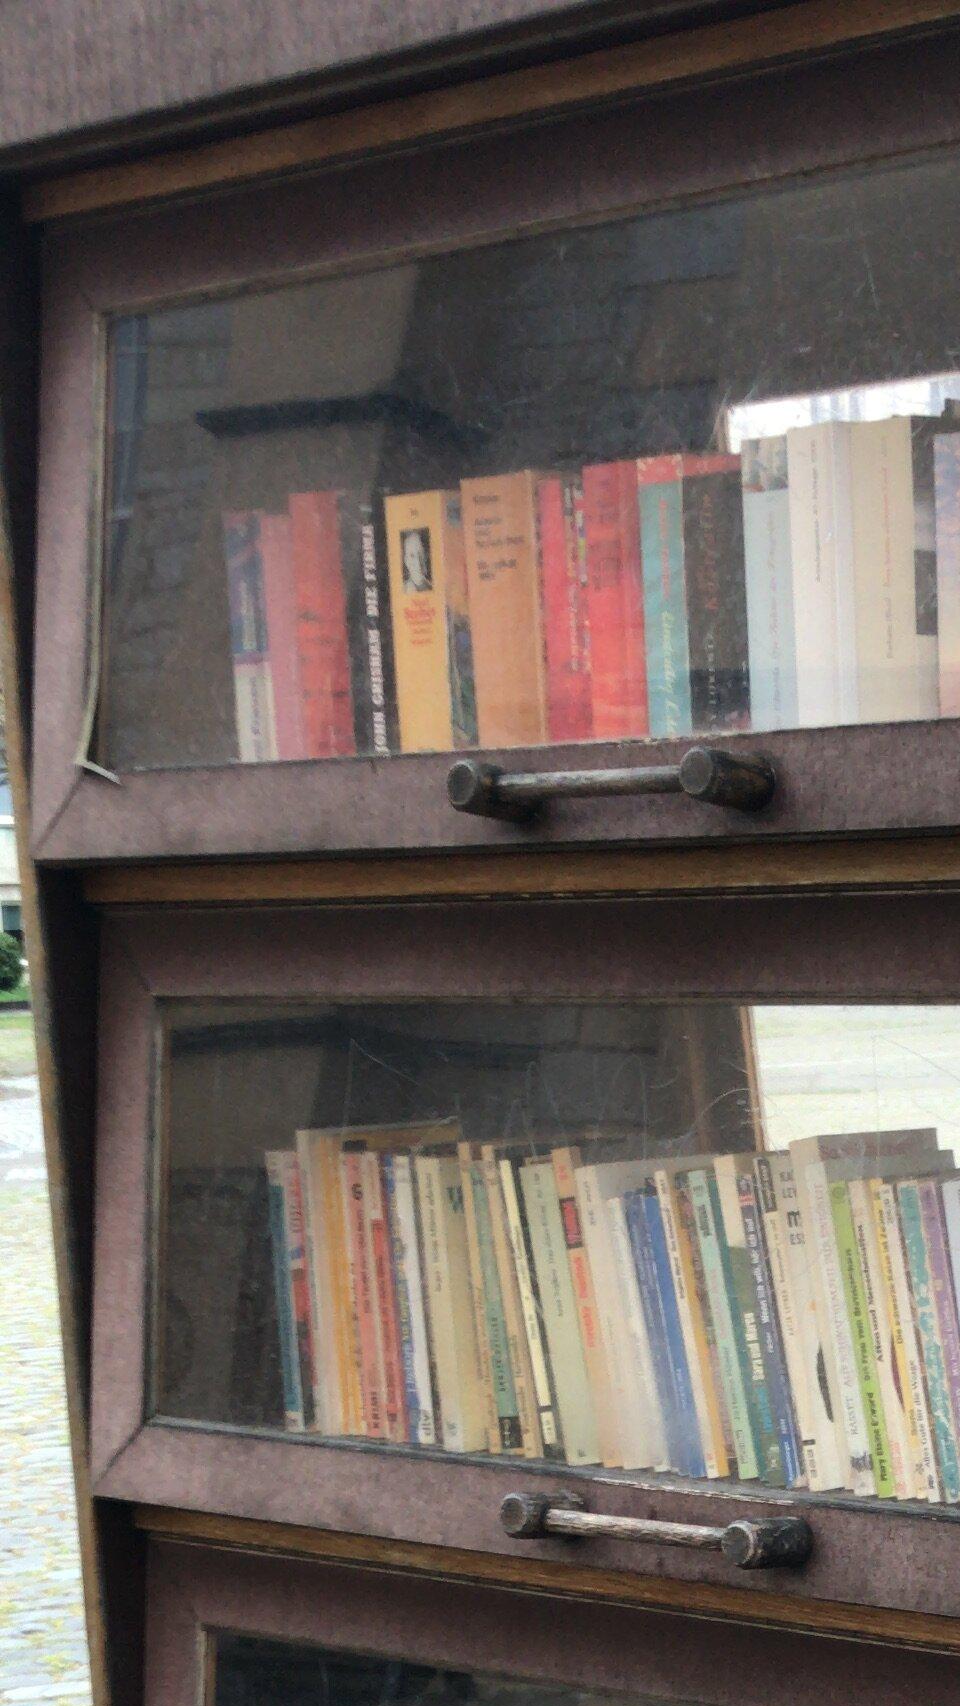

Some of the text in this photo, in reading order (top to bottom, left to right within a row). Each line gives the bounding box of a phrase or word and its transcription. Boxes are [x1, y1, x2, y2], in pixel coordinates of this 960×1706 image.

[372, 711, 389, 757] JOHN
[908, 1359, 922, 1391] Waage
[875, 1457, 887, 1482] Mary
